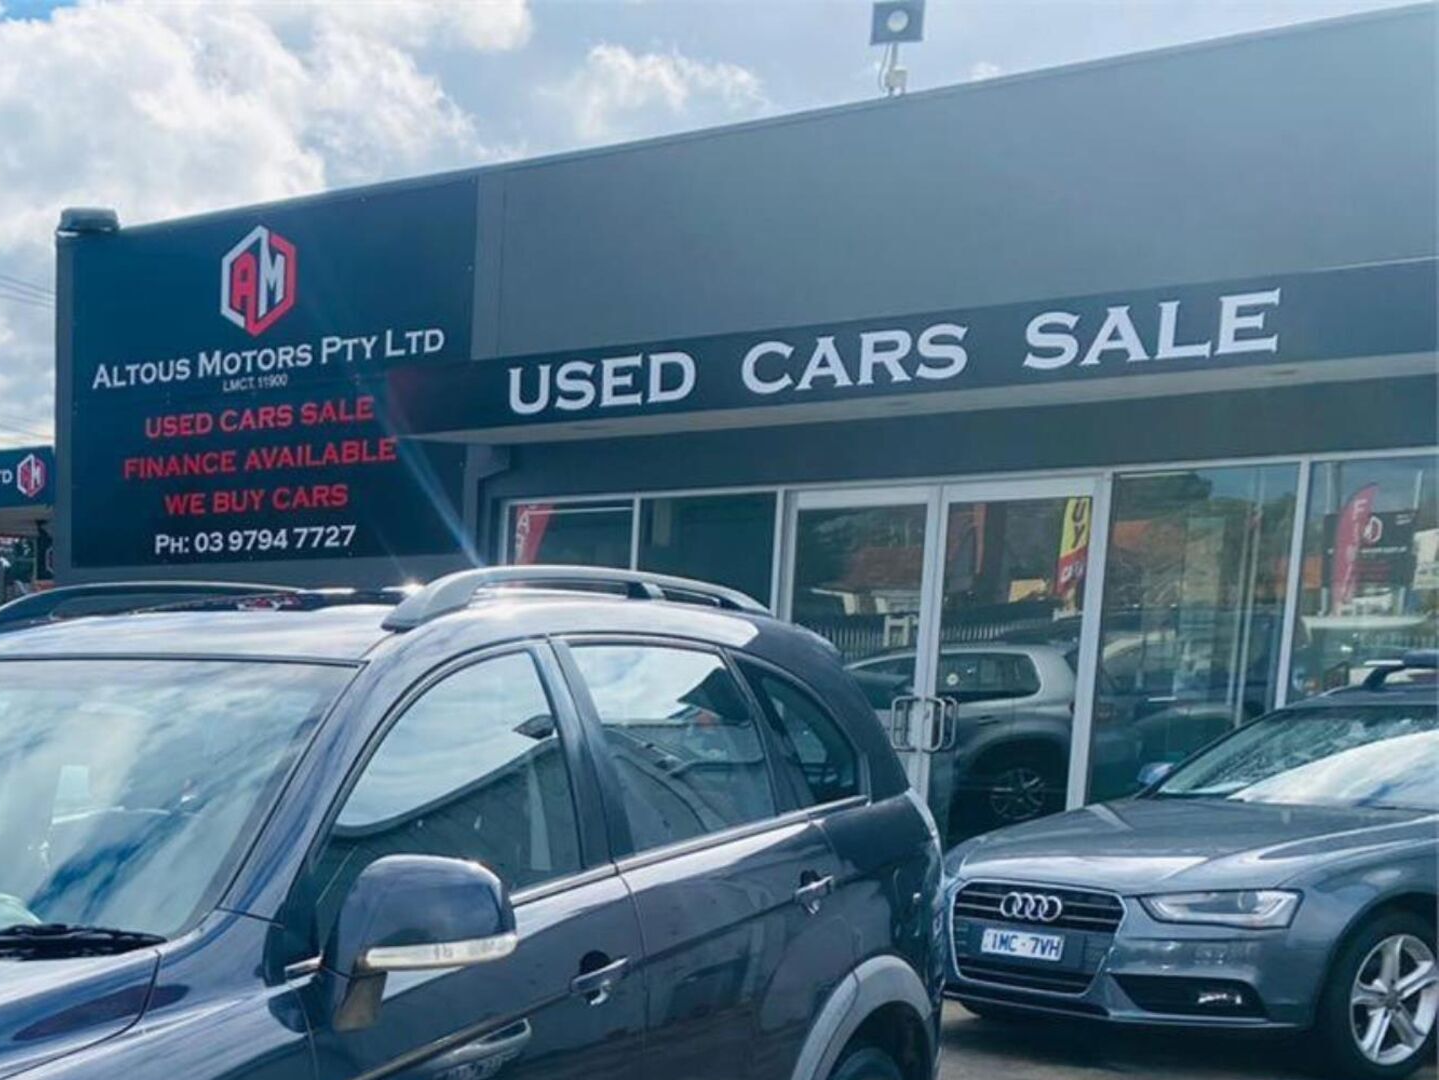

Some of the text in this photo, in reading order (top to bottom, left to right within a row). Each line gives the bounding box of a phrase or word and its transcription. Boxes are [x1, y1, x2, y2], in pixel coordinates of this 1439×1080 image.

[92, 328, 445, 389] ALTOUS MOTORS PTY LTD
[509, 287, 1281, 415] USED CARS SALE
[145, 396, 375, 438] USED CARS SALE
[123, 436, 398, 480] FINANCE AVAILABLE
[165, 484, 349, 516] WE BUY CARS
[194, 531, 223, 552] 03
[228, 529, 288, 550] 9794
[294, 525, 357, 548] 7727
[1029, 936, 1061, 957] 7VH
